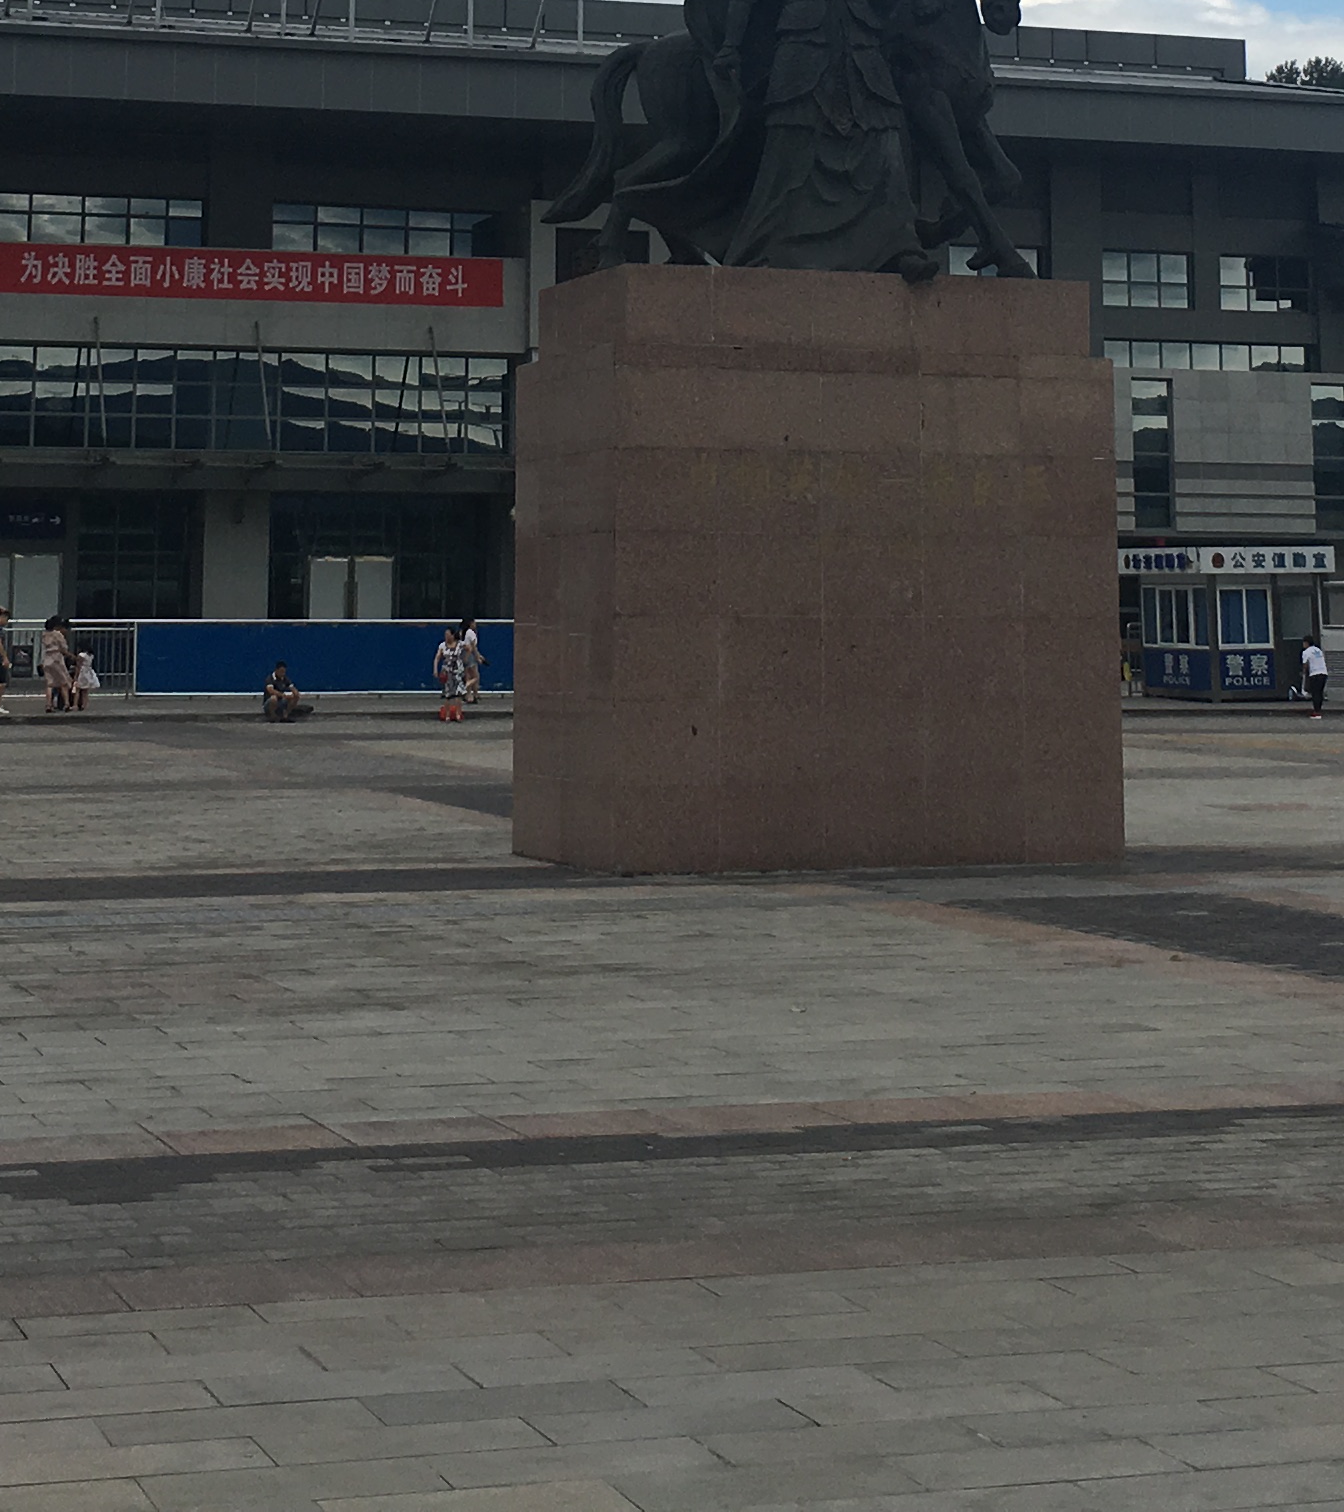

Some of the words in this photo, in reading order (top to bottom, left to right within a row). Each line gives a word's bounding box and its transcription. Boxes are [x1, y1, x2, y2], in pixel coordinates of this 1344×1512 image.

[19, 252, 469, 298] 为决胜全面小康社会实现中国梦而奋斗
[1225, 654, 1269, 676] 警察
[1225, 676, 1271, 686] POLICE
